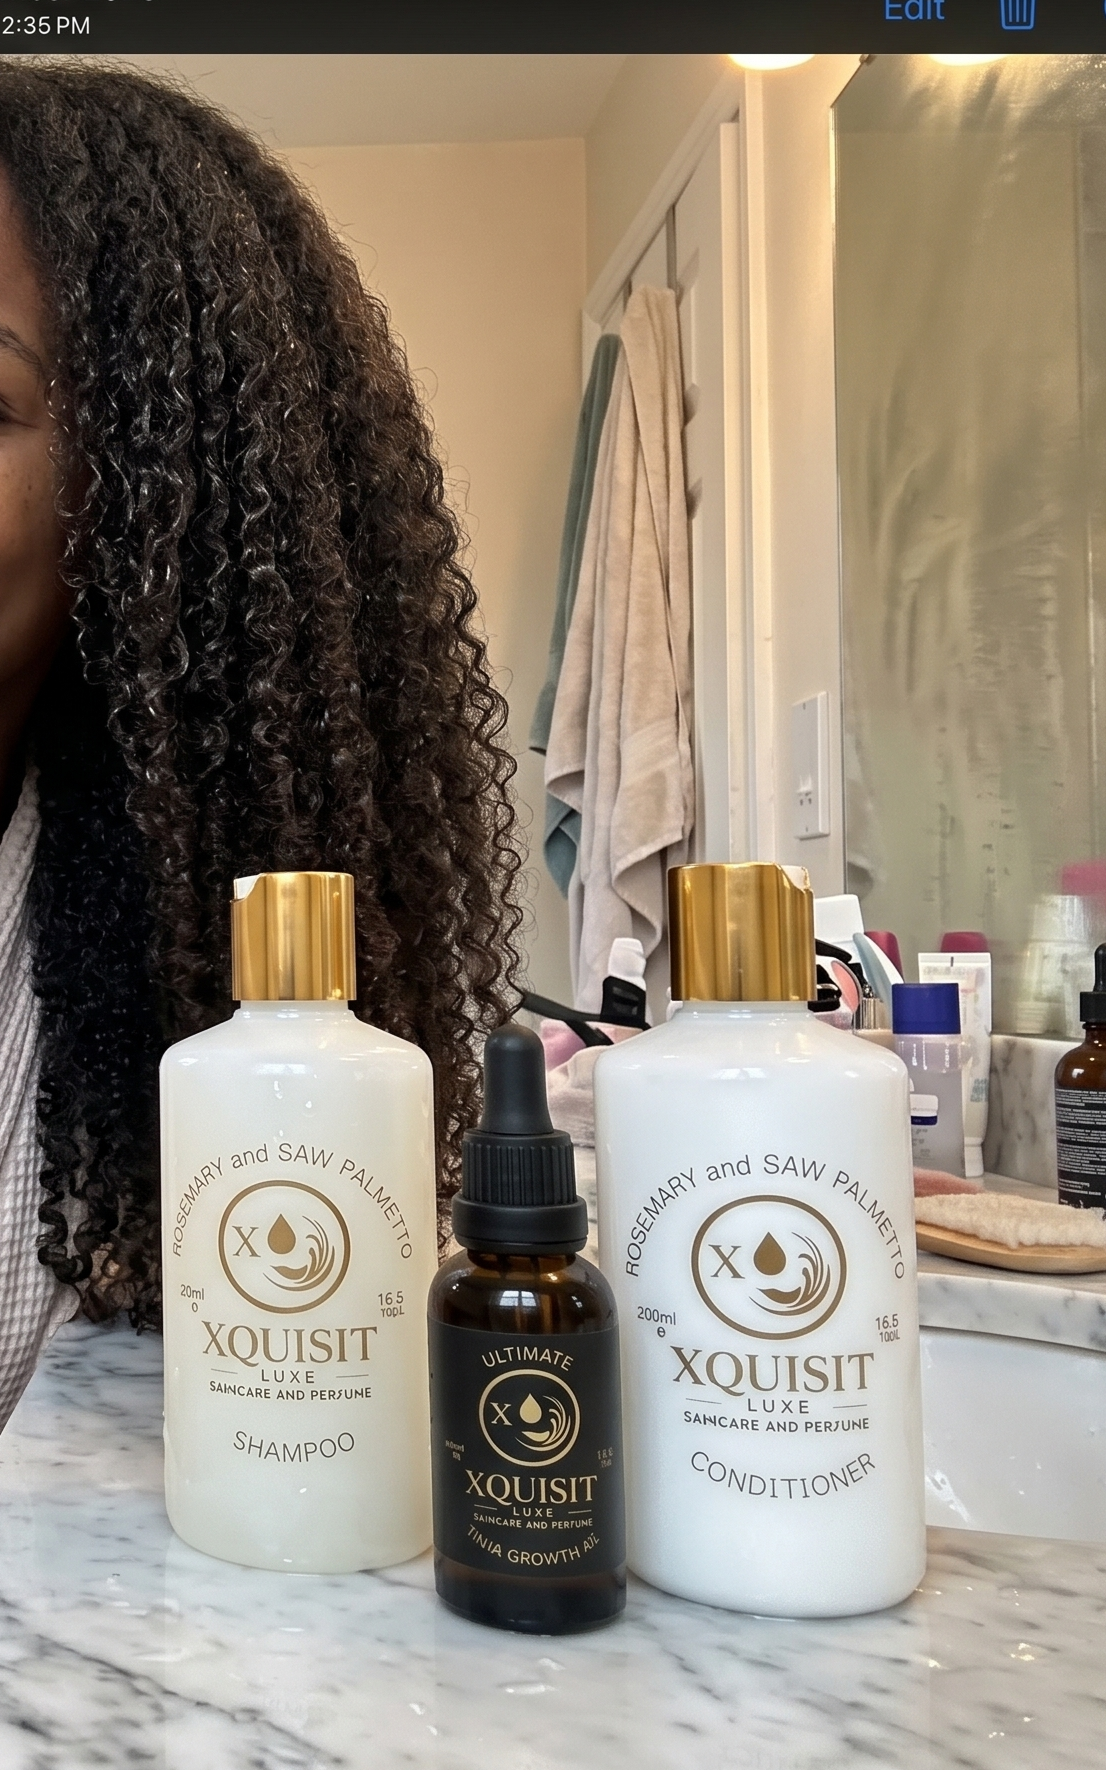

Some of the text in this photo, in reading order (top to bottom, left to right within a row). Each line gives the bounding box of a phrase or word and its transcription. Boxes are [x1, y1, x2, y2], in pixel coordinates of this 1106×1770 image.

[172, 1142, 413, 1260] ROSEMARY and SAW PALMETTO
[626, 1154, 905, 1280] ROSEMARY and SAW PALMETTO
[231, 1225, 262, 1259] X
[708, 1243, 746, 1280] X
[637, 1305, 677, 1326] 200ml
[875, 1313, 899, 1331] 16.5
[201, 1320, 378, 1368] XQUISIT
[481, 1346, 574, 1372] ULTIMATE
[670, 1345, 874, 1397] XQUISIT
[261, 1369, 315, 1384] LUXE
[276, 1389, 305, 1401] AND
[747, 1398, 810, 1414] LUXE
[490, 1402, 513, 1426] X
[765, 1420, 799, 1433] AND
[233, 1430, 355, 1463] SHAMPOO
[465, 1469, 598, 1506] XQUISIT
[690, 1451, 876, 1500] CONDITIONER
[513, 1506, 554, 1518] LUXE
[525, 1520, 548, 1530] AND
[507, 1545, 581, 1567] GROWTH
